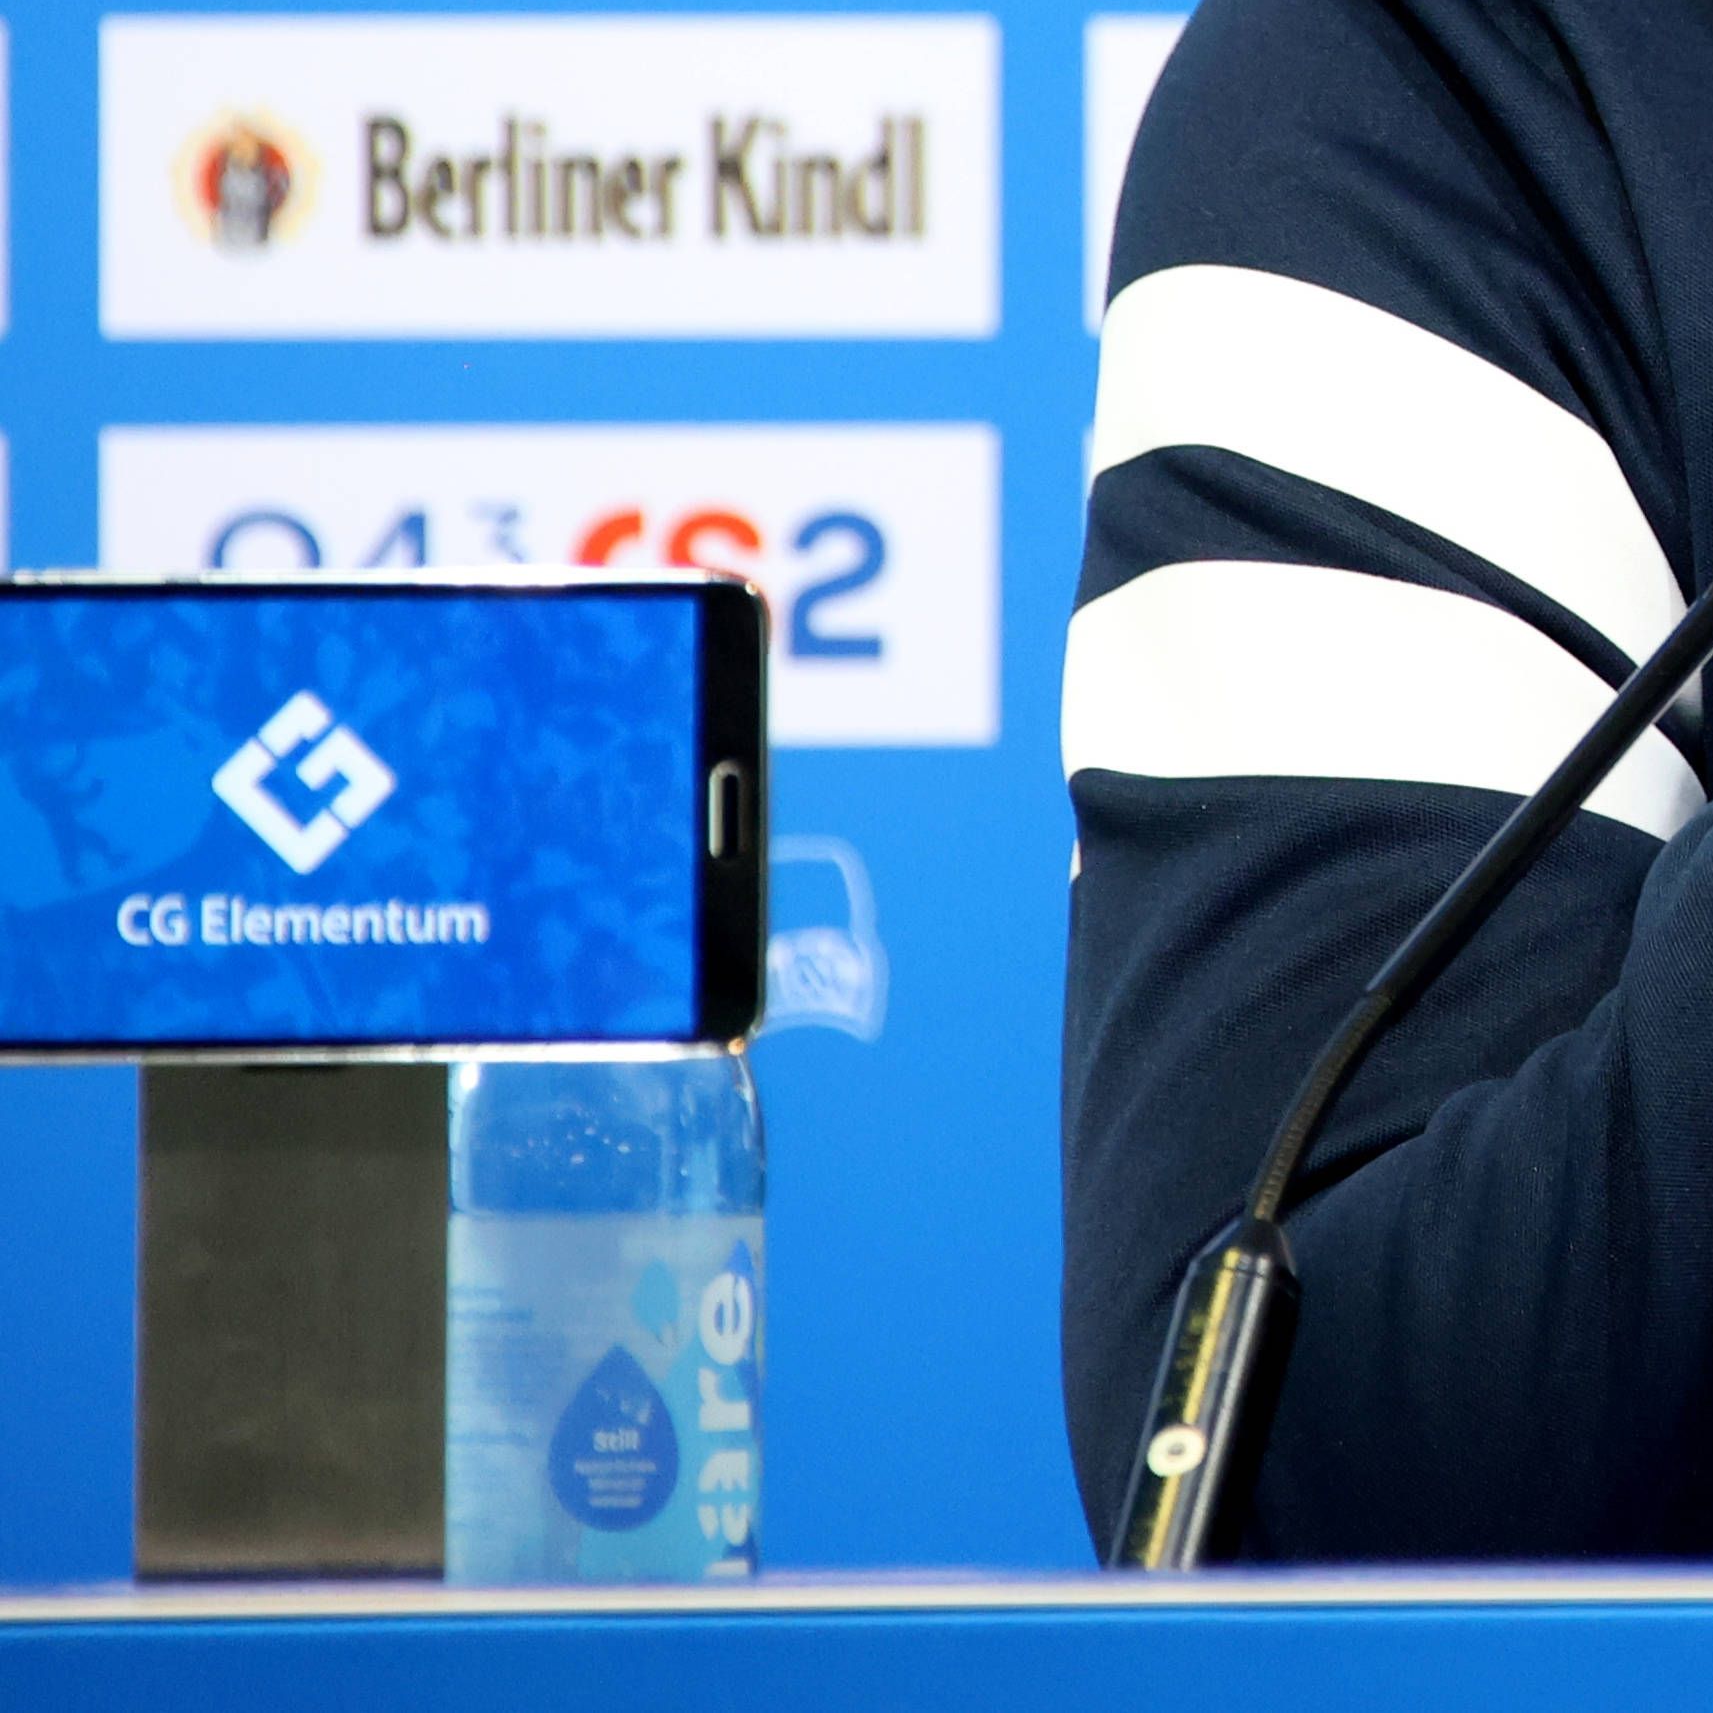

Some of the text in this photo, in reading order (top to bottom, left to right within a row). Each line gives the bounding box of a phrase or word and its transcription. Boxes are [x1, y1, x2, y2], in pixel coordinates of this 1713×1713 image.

[362, 110, 927, 243] Berliner Kindl
[116, 892, 491, 947] CG Elementum
[698, 1271, 753, 1576] are
